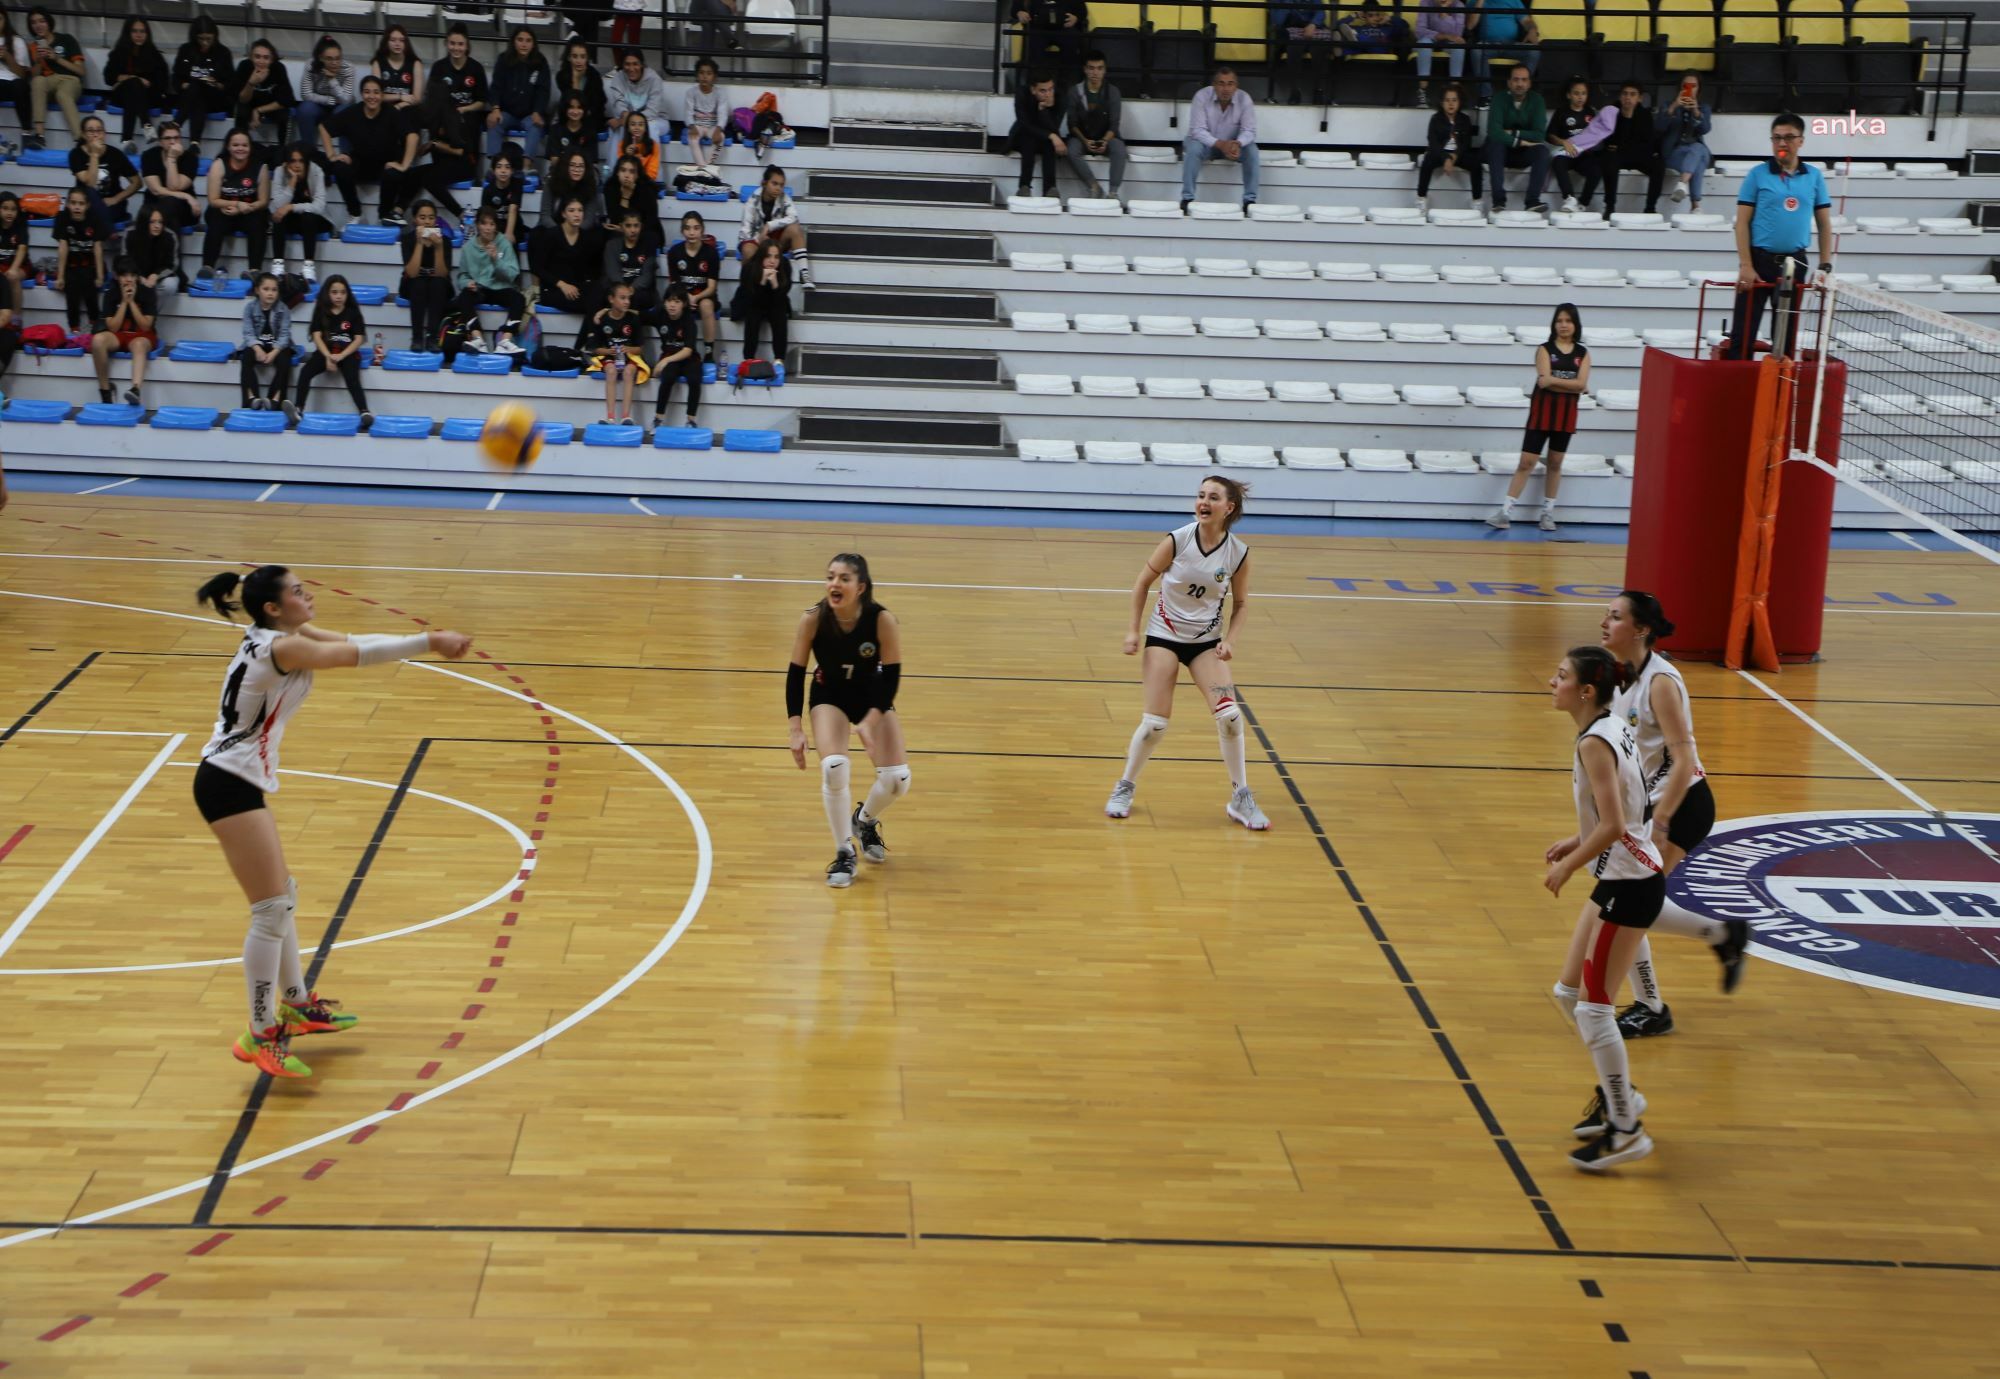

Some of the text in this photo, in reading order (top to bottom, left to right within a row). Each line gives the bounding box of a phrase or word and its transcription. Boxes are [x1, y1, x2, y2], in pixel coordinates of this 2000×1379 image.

[1187, 583, 1206, 599] 20
[841, 664, 854, 680] 7
[222, 661, 247, 734] 4
[1901, 823, 1988, 839] VE
[1605, 896, 1616, 913] 4
[1795, 887, 2000, 918] TUR
